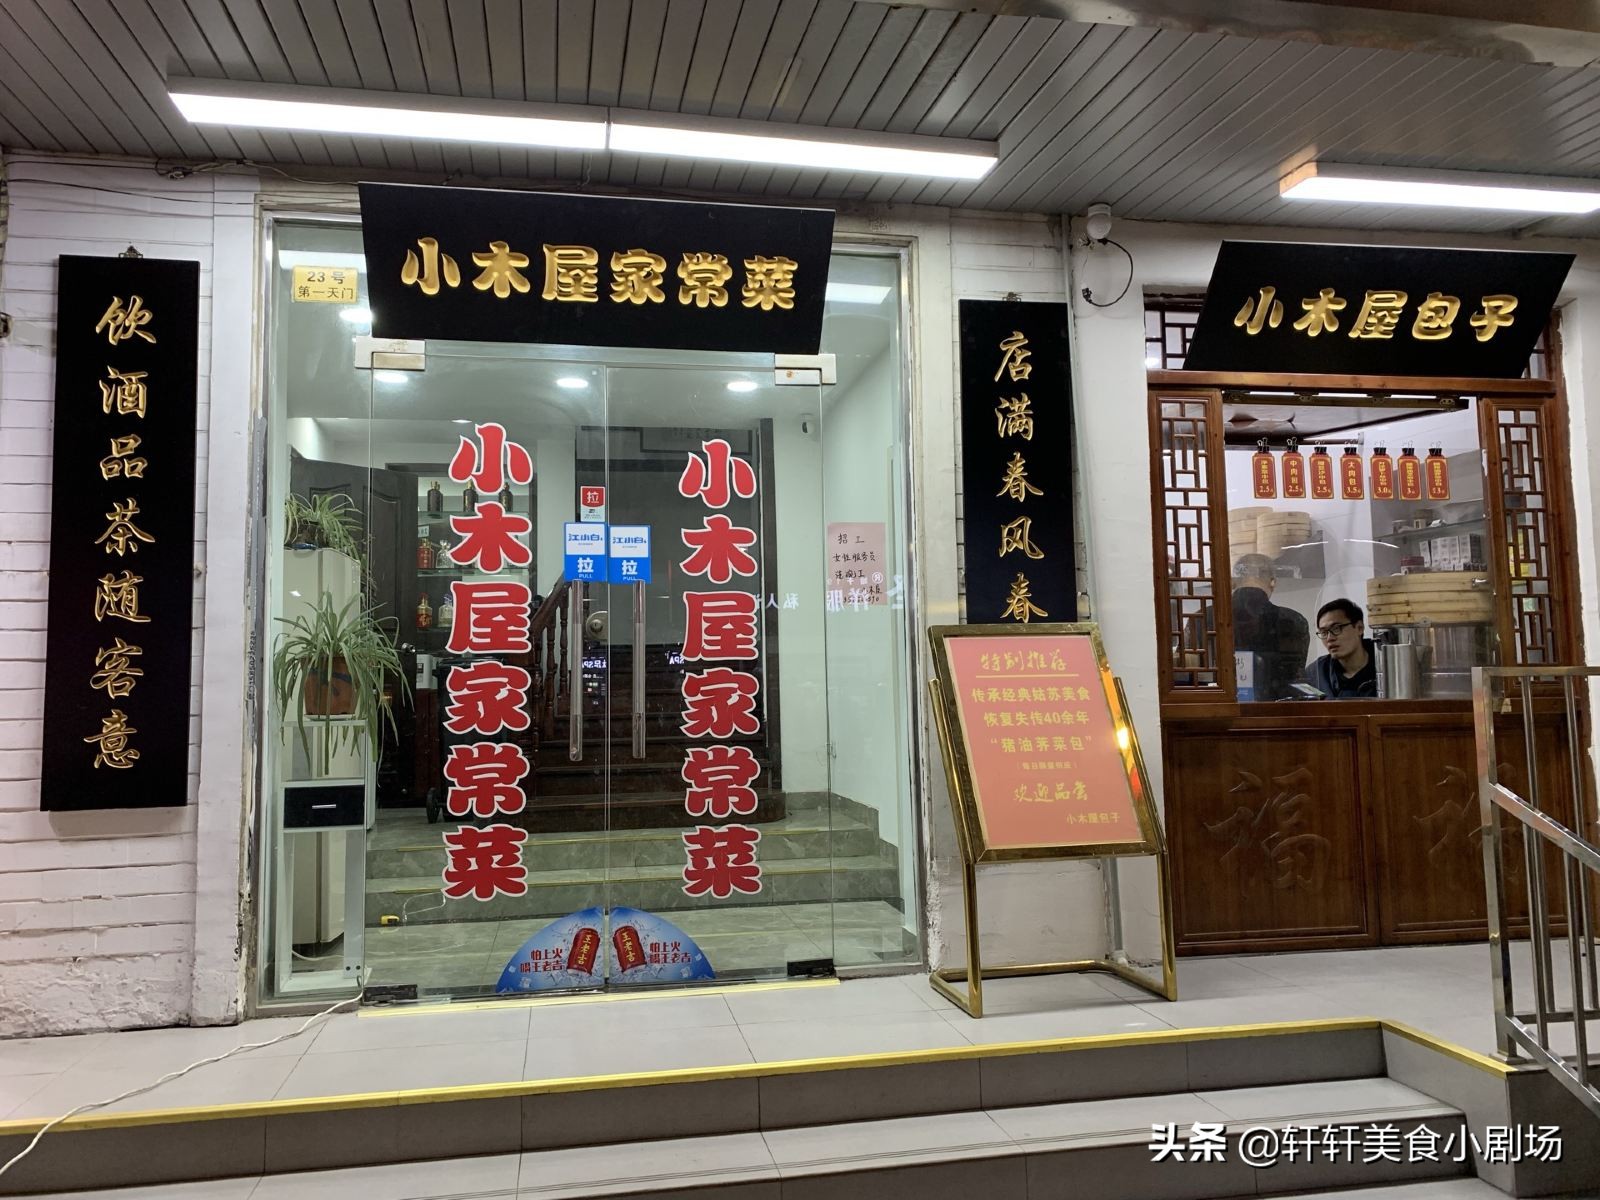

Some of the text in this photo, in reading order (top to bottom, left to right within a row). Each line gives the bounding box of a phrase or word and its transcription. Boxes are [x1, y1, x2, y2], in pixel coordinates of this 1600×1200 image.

[400, 238, 798, 310] 小木屋家常菜
[298, 285, 354, 300] 第一天门
[1233, 286, 1520, 343] 小木屋包子
[993, 330, 1050, 625] 店满春风春
[1347, 461, 1356, 486] 大肉包
[586, 491, 600, 504] 拉
[83, 294, 157, 770] 饮酒品茶随客意
[568, 533, 600, 542] 江小白
[612, 536, 644, 544] 江小白
[577, 557, 594, 573] 拉
[833, 551, 876, 563] 女性服务员
[621, 559, 638, 576] 拉
[441, 422, 534, 901] 小木屋家常菜
[678, 437, 763, 899] 小木屋家常菜
[980, 649, 1067, 672] 特别推荐
[971, 686, 1091, 703] 传承经典姑苏美食
[983, 710, 1090, 728] 恢复失传40余年
[1066, 811, 1121, 825] 小木屋包子
[530, 947, 564, 961] 怕上火
[578, 934, 592, 965] 王老吉
[620, 931, 635, 963] 王老吉
[649, 940, 682, 954] 怕上火
[649, 951, 693, 965] 喝王老吉
[519, 961, 564, 974] 喝王老吉
